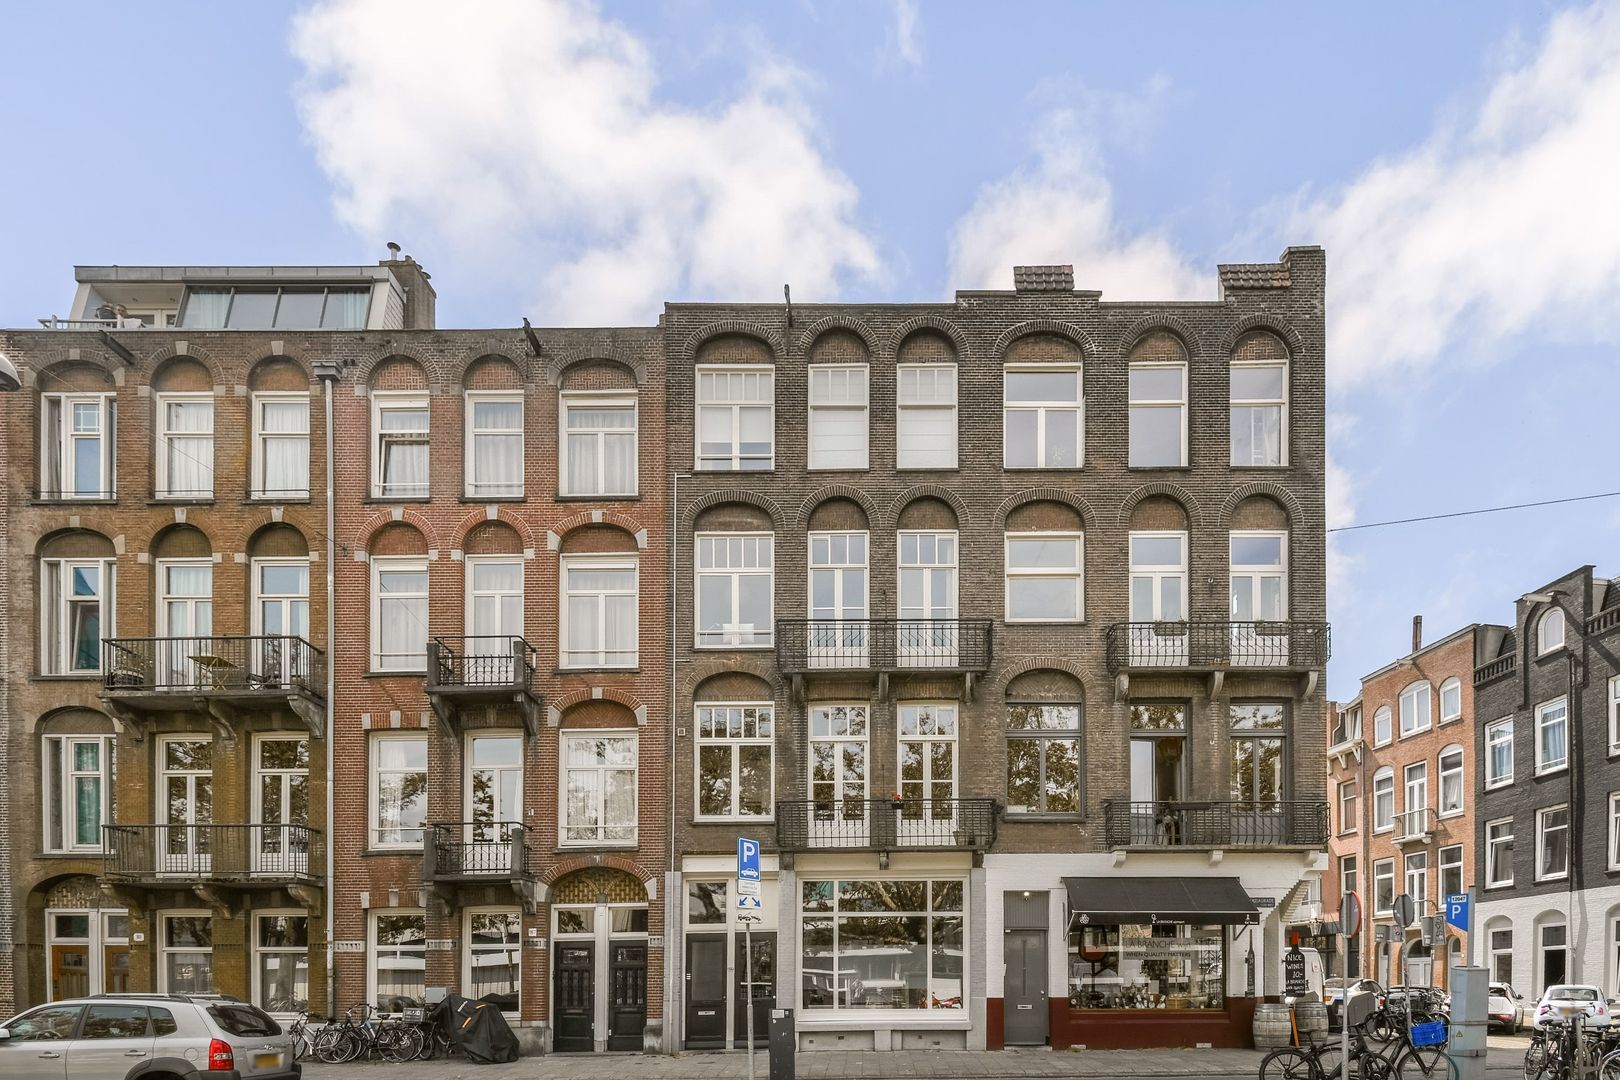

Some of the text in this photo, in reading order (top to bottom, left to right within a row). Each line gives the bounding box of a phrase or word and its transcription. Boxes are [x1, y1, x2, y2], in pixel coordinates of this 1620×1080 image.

[744, 842, 755, 862] P
[1452, 905, 1461, 919] P
[1125, 940, 1136, 948] LA
[1137, 940, 1175, 948] BRANCHE
